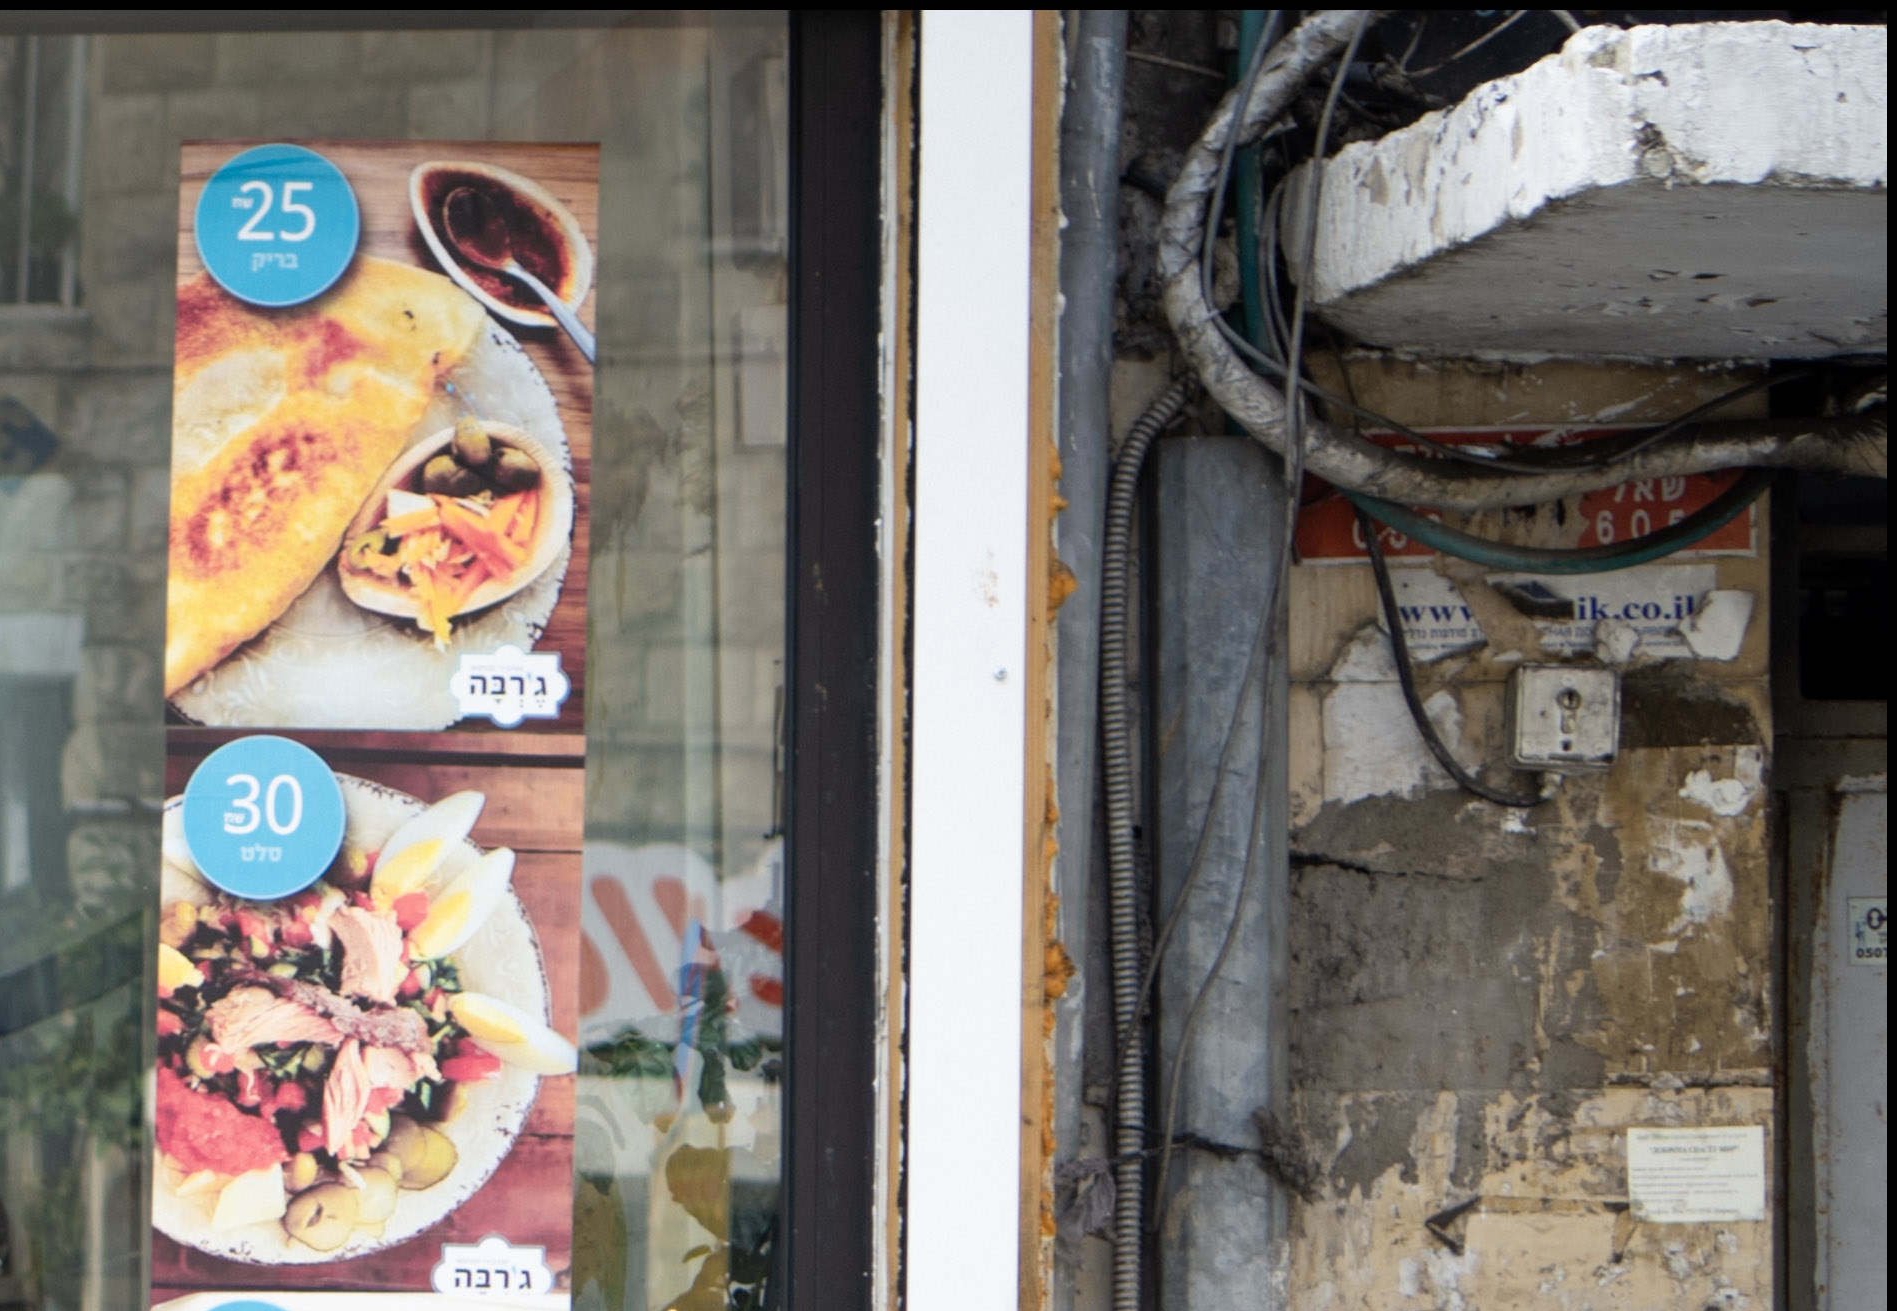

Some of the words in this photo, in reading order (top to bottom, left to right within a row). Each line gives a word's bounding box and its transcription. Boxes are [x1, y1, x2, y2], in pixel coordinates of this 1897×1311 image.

[237, 180, 316, 242] 25
[251, 251, 299, 272] בריק
[223, 773, 304, 836] 30
[240, 842, 283, 863] סלט
